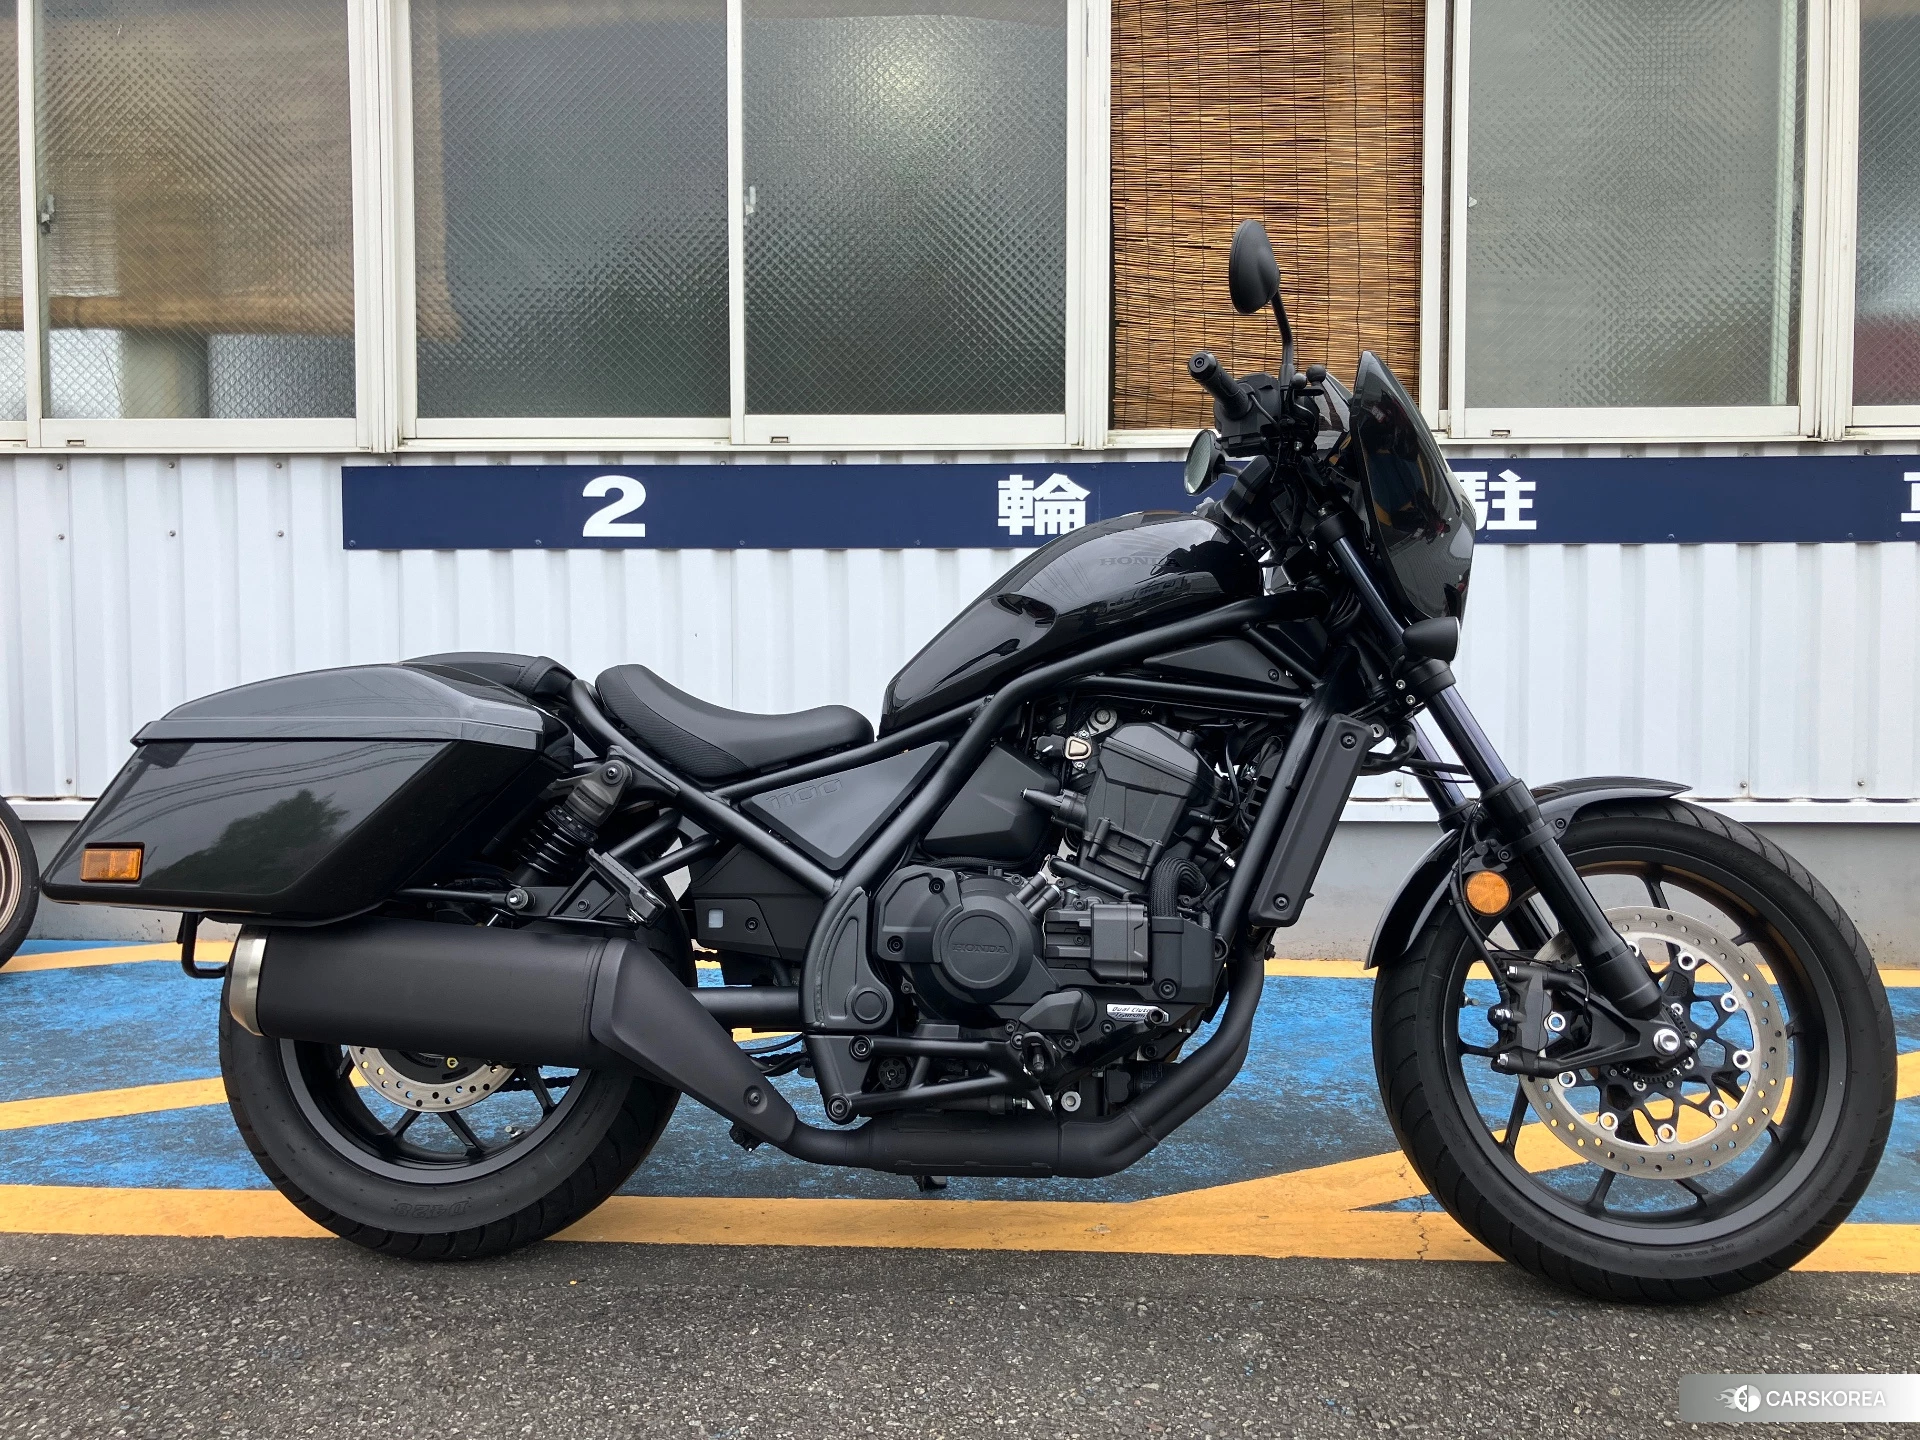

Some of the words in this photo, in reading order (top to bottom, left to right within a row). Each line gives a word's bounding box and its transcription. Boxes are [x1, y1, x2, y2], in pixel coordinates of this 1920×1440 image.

[583, 475, 646, 537] 2
[998, 473, 1091, 535] 輪
[766, 778, 843, 809] 1100
[952, 943, 1009, 954] HONDA
